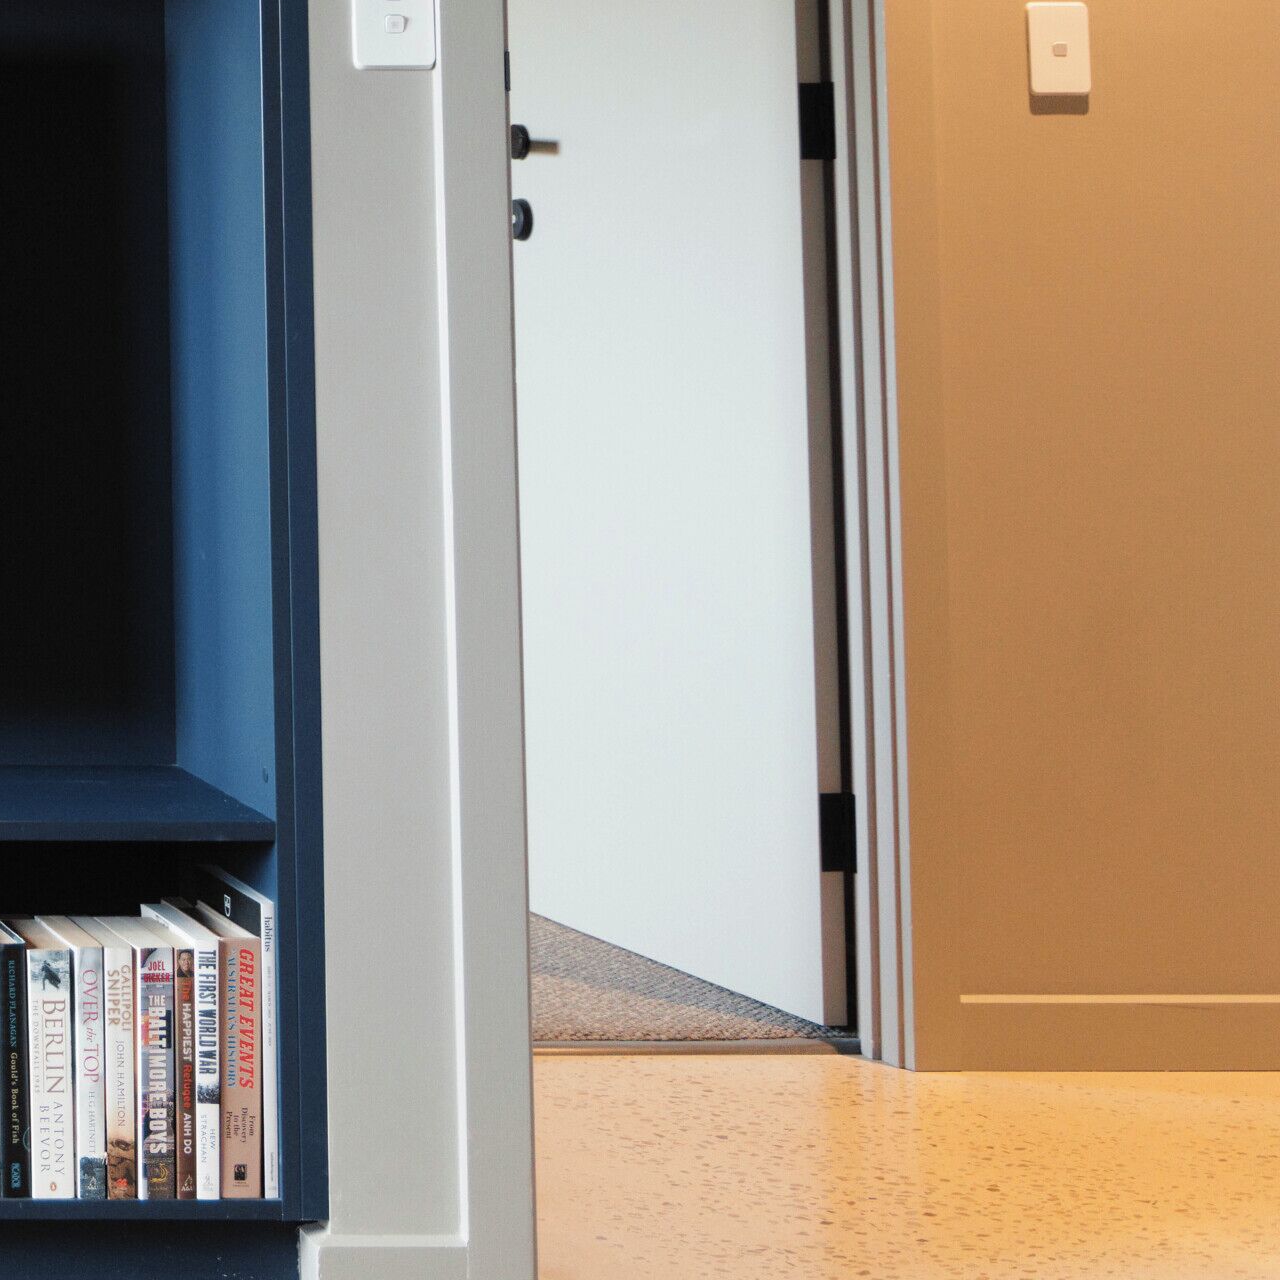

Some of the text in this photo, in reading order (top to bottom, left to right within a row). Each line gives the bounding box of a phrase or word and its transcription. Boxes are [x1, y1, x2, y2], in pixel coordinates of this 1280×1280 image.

[41, 999, 66, 1094] BERLIN
[197, 950, 217, 1075] THE FIRST WORLD WAR
[239, 948, 255, 1088] GREAT EVENTS
